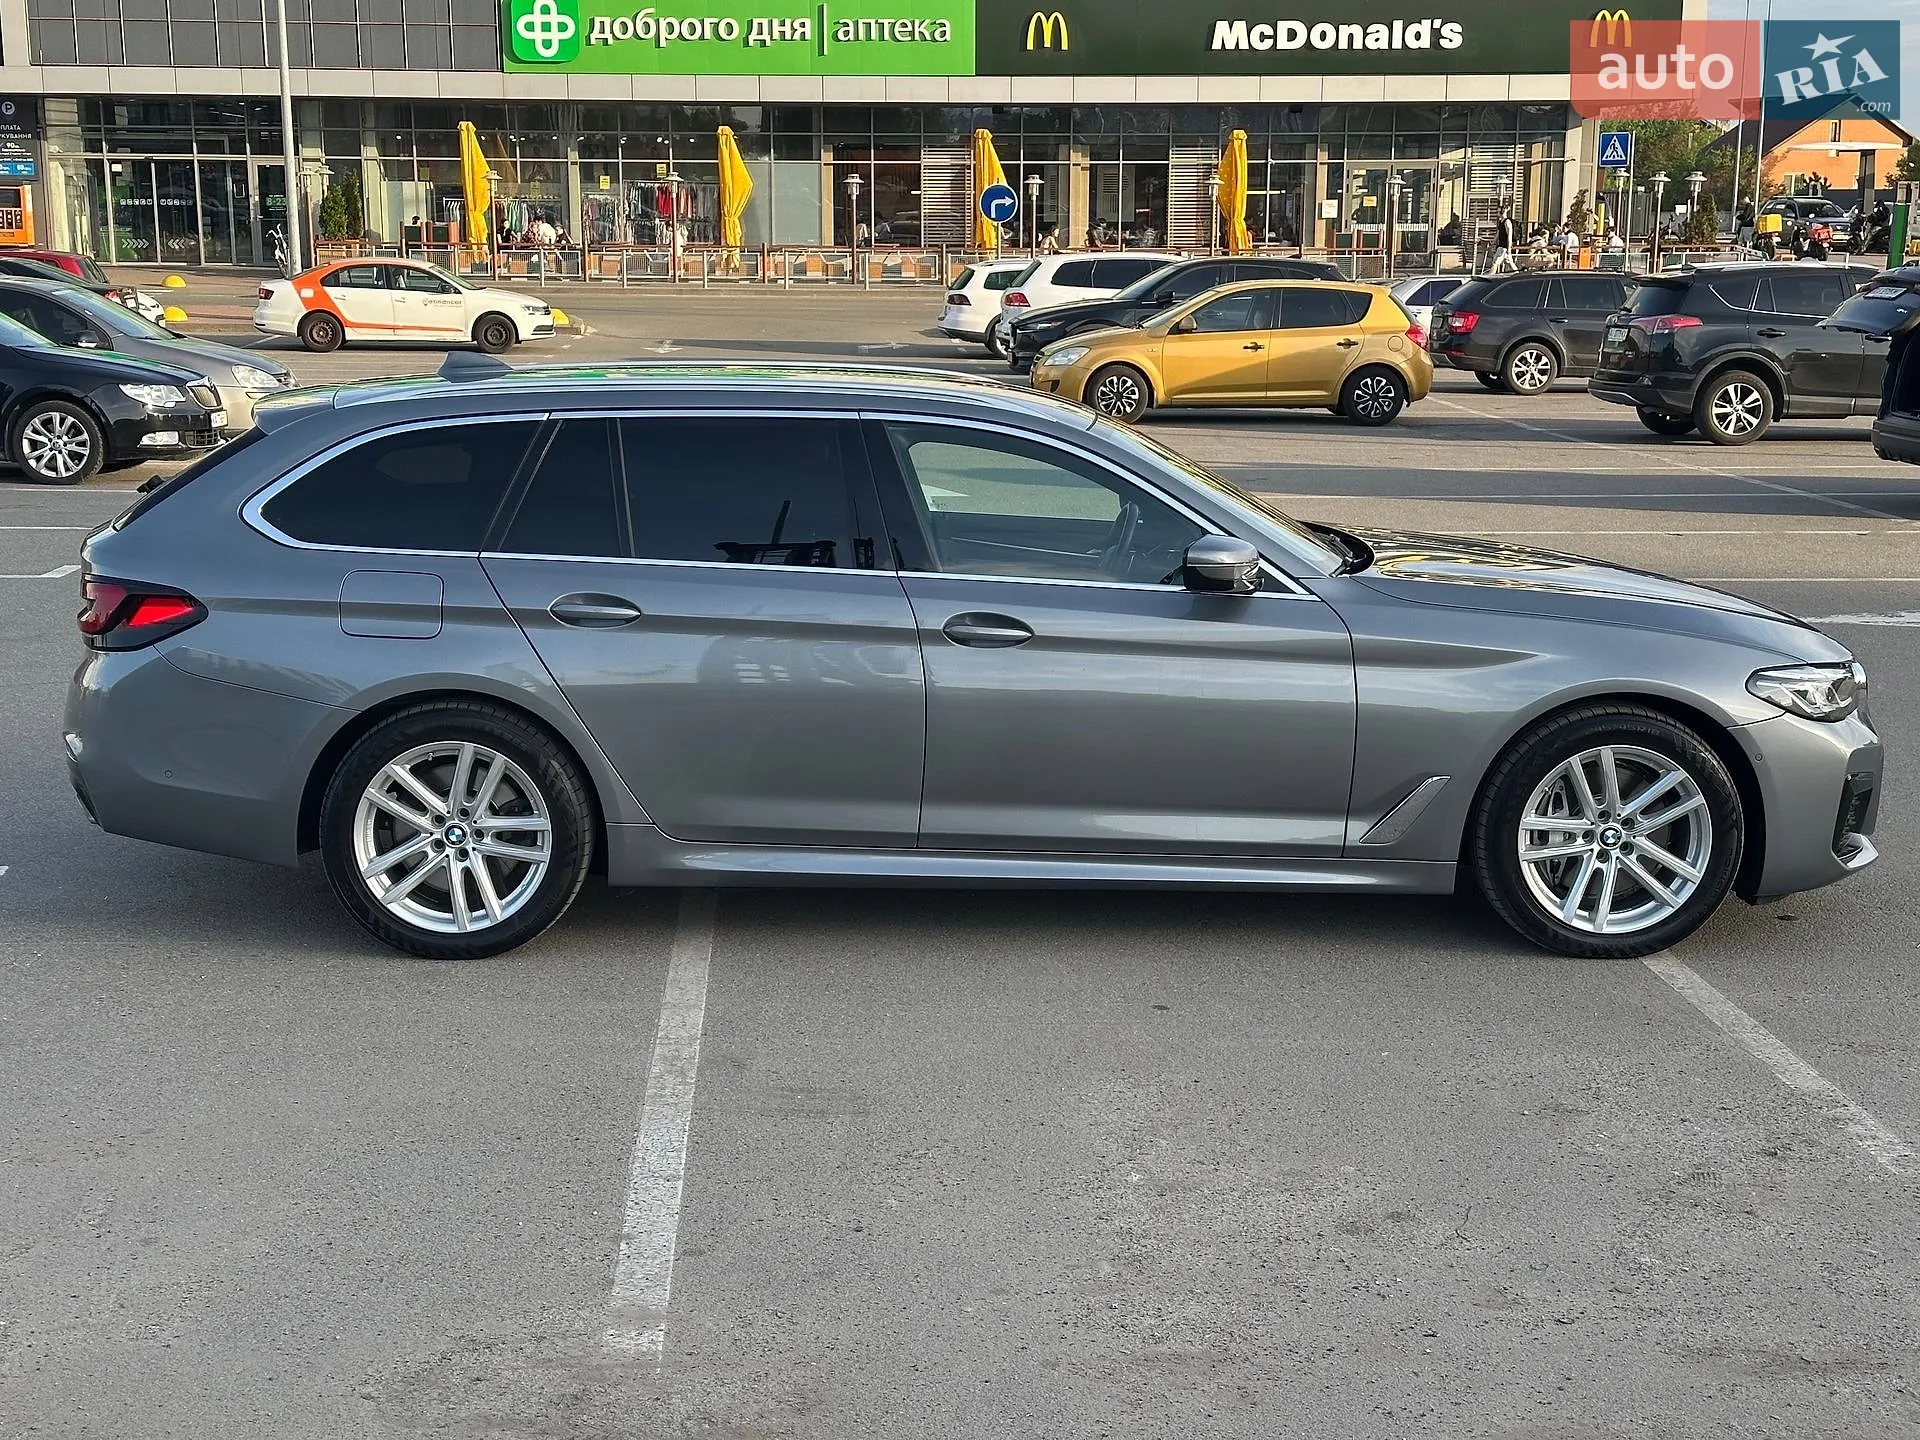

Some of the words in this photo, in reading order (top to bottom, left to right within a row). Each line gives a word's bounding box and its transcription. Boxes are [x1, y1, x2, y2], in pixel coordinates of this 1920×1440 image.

[588, 7, 740, 48] доброго
[746, 17, 812, 46] дня
[836, 17, 951, 42] аптека
[1210, 18, 1464, 51] McDonald's
